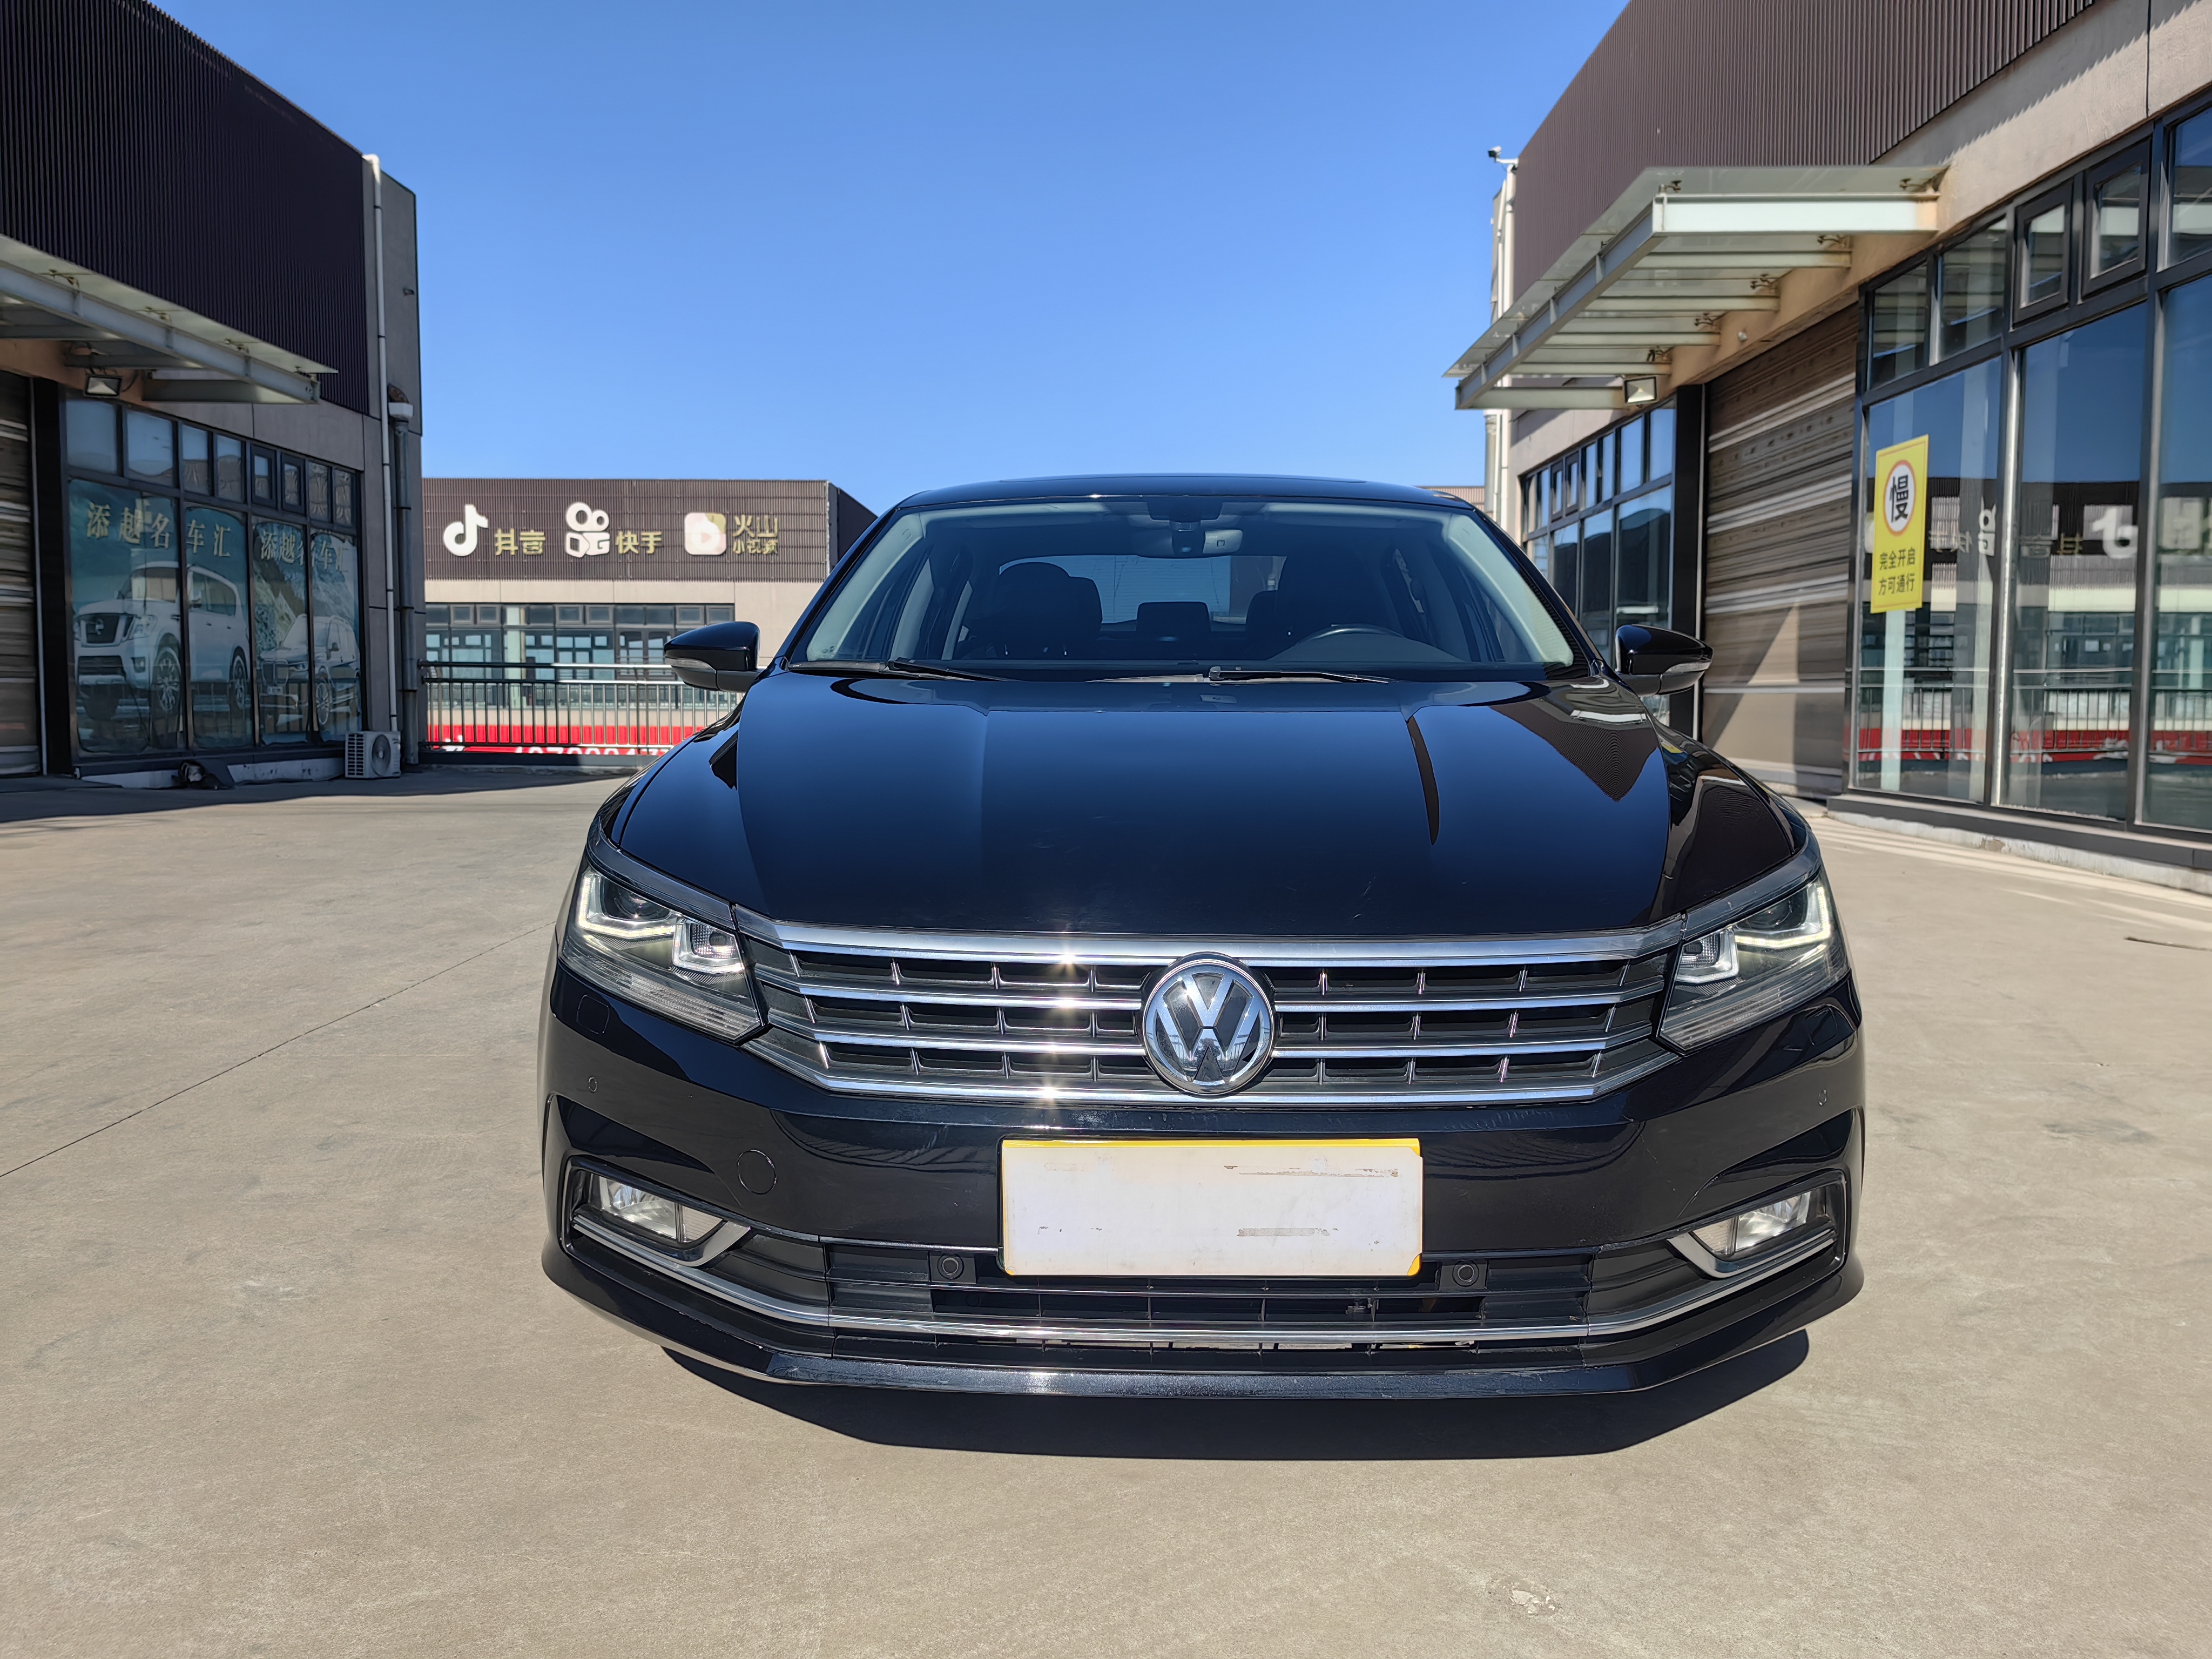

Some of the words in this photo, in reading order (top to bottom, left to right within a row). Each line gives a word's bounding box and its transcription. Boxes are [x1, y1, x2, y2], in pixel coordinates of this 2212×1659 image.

[1889, 474, 1909, 523] 慢
[732, 514, 778, 538] 火山
[495, 528, 545, 556] 抖音
[615, 531, 663, 554] 快手
[733, 539, 778, 555] 小视频
[1879, 547, 1916, 570] 完全开启
[1878, 573, 1915, 596] 方可通行
[1148, 963, 1269, 1091] VW
